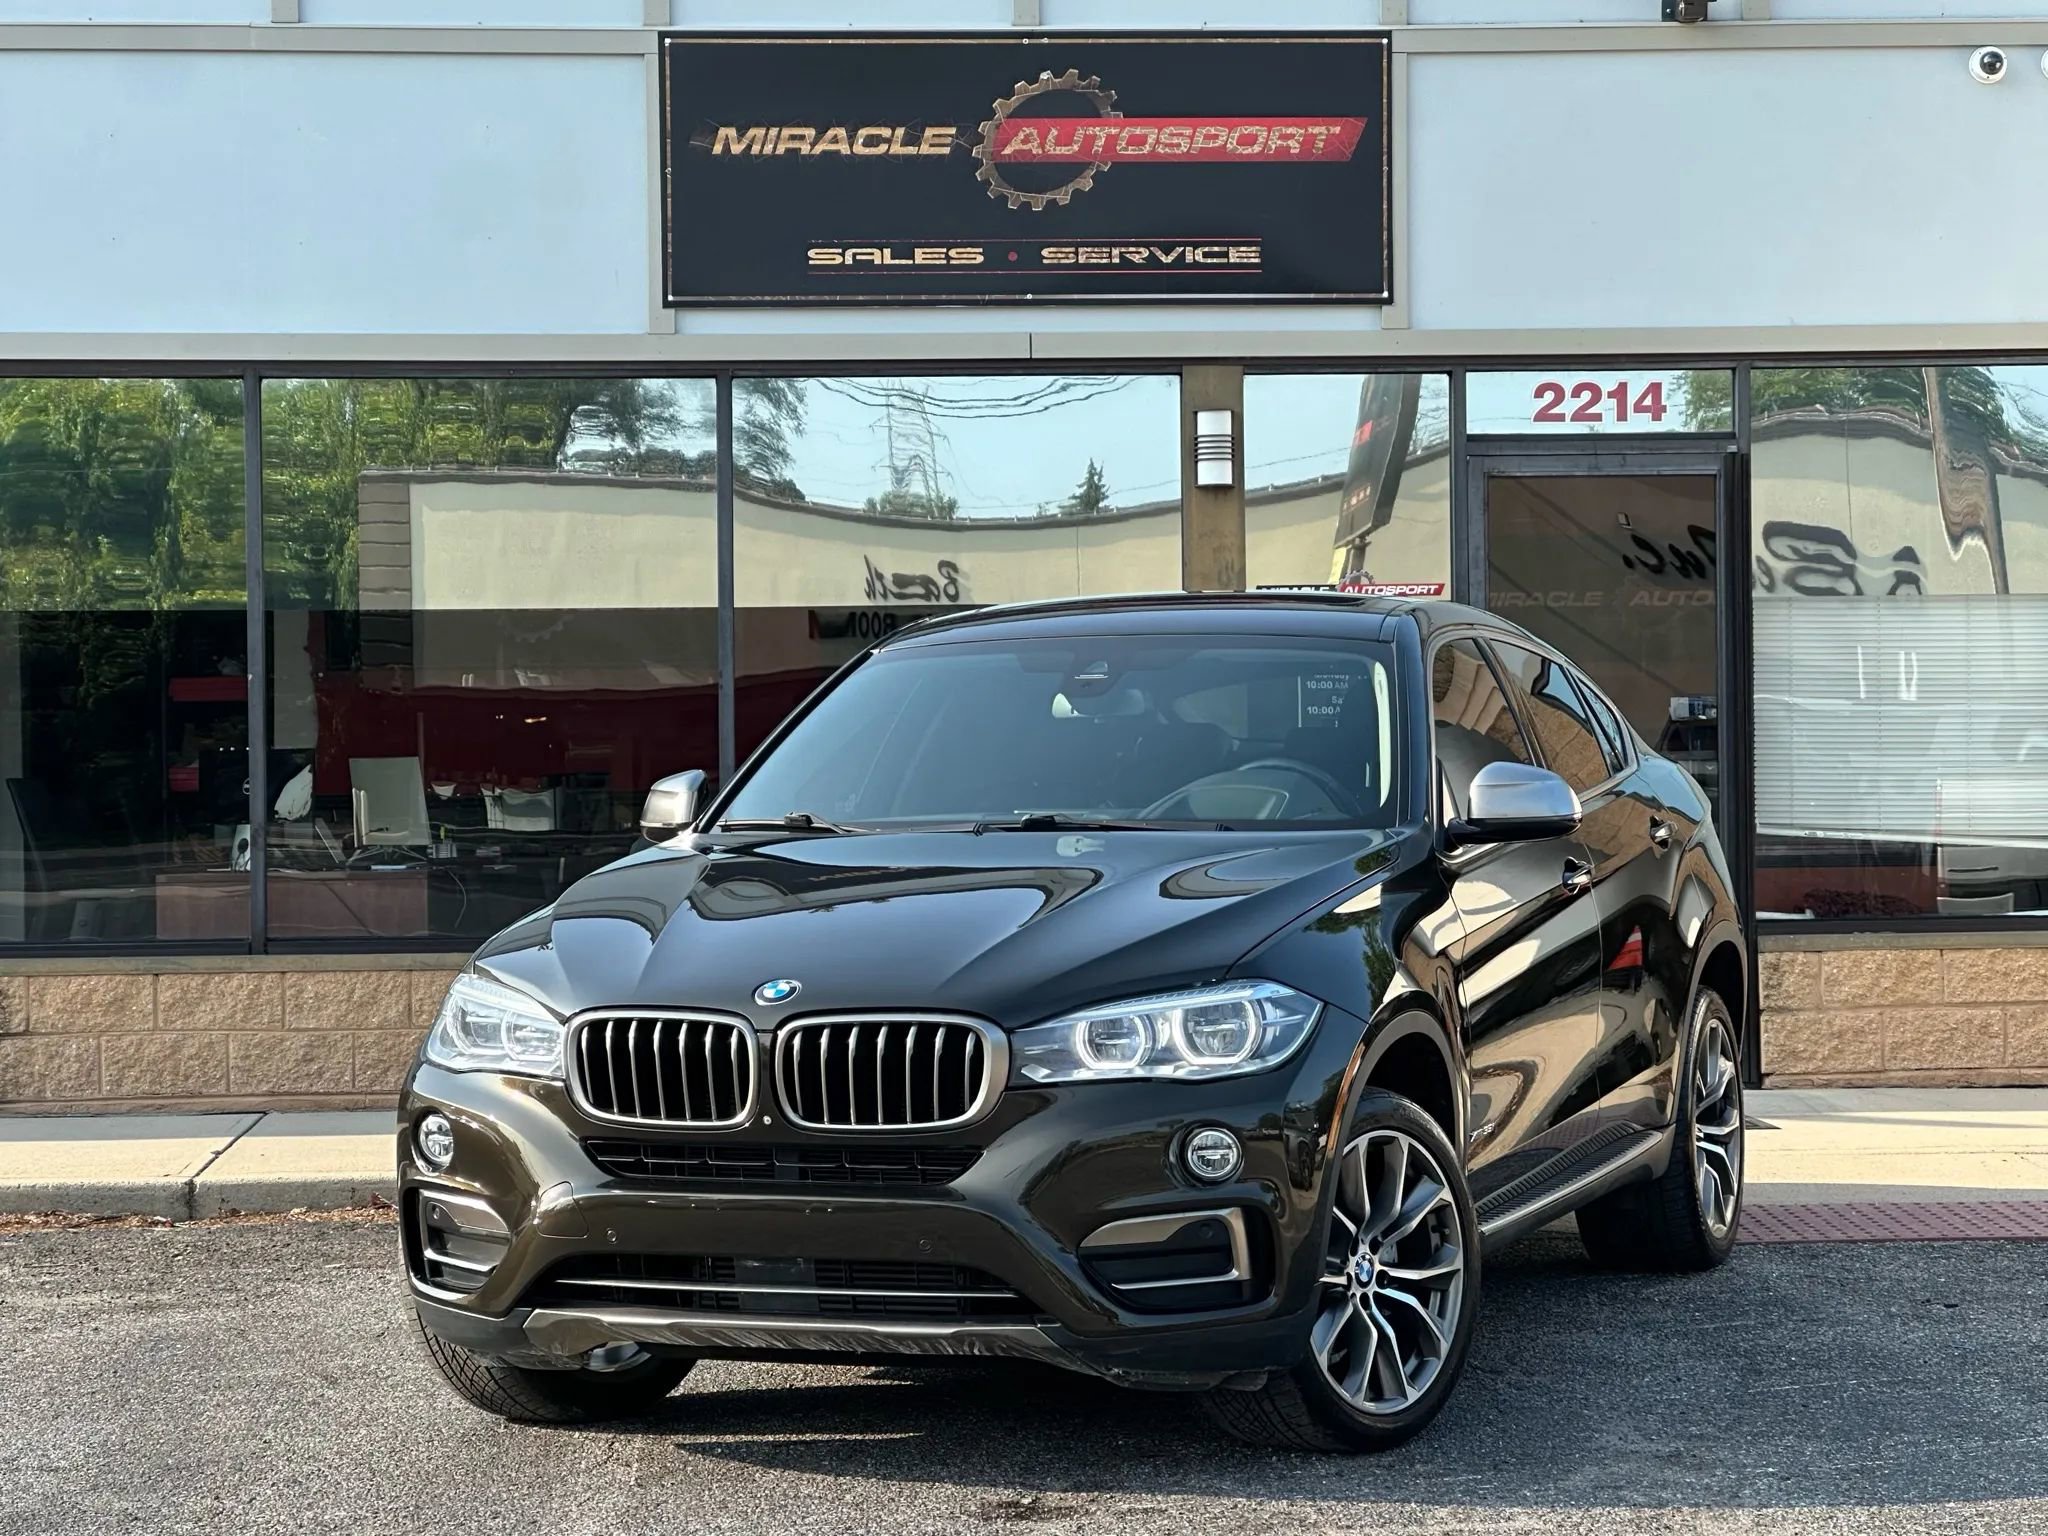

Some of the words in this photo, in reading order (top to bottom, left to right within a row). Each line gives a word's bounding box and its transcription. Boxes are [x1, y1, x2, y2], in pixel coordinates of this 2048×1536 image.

[712, 127, 957, 155] MIRACLE
[1001, 126, 1341, 155] AUTOSPORT
[807, 247, 984, 265] SALES
[1041, 246, 1261, 264] SERVICE
[1532, 380, 1668, 423] 2214
